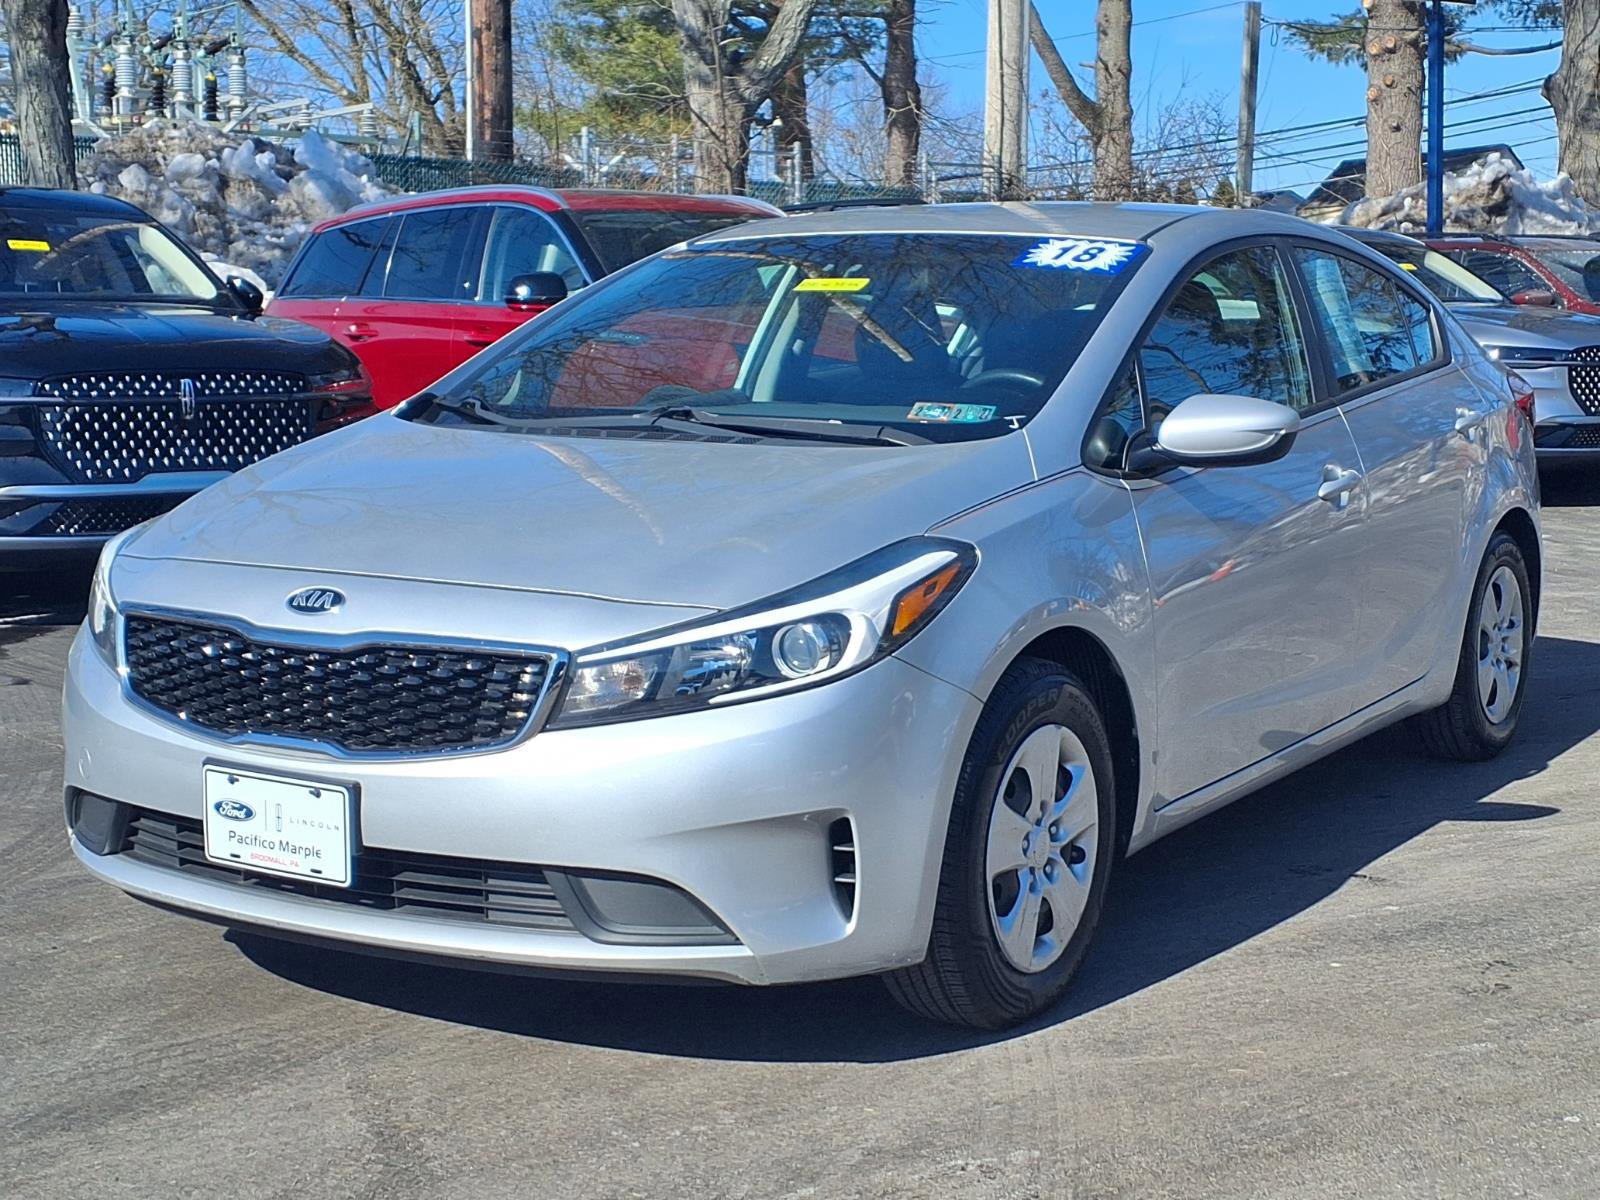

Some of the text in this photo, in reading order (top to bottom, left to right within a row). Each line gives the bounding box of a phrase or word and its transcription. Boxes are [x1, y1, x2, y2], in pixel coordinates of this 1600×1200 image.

[1051, 244, 1106, 263] 18
[292, 590, 334, 609] KIA
[218, 800, 248, 819] Ford
[289, 817, 340, 831] LINCOLN
[228, 830, 322, 859] Pacifico Marple
[290, 859, 300, 868] PA
